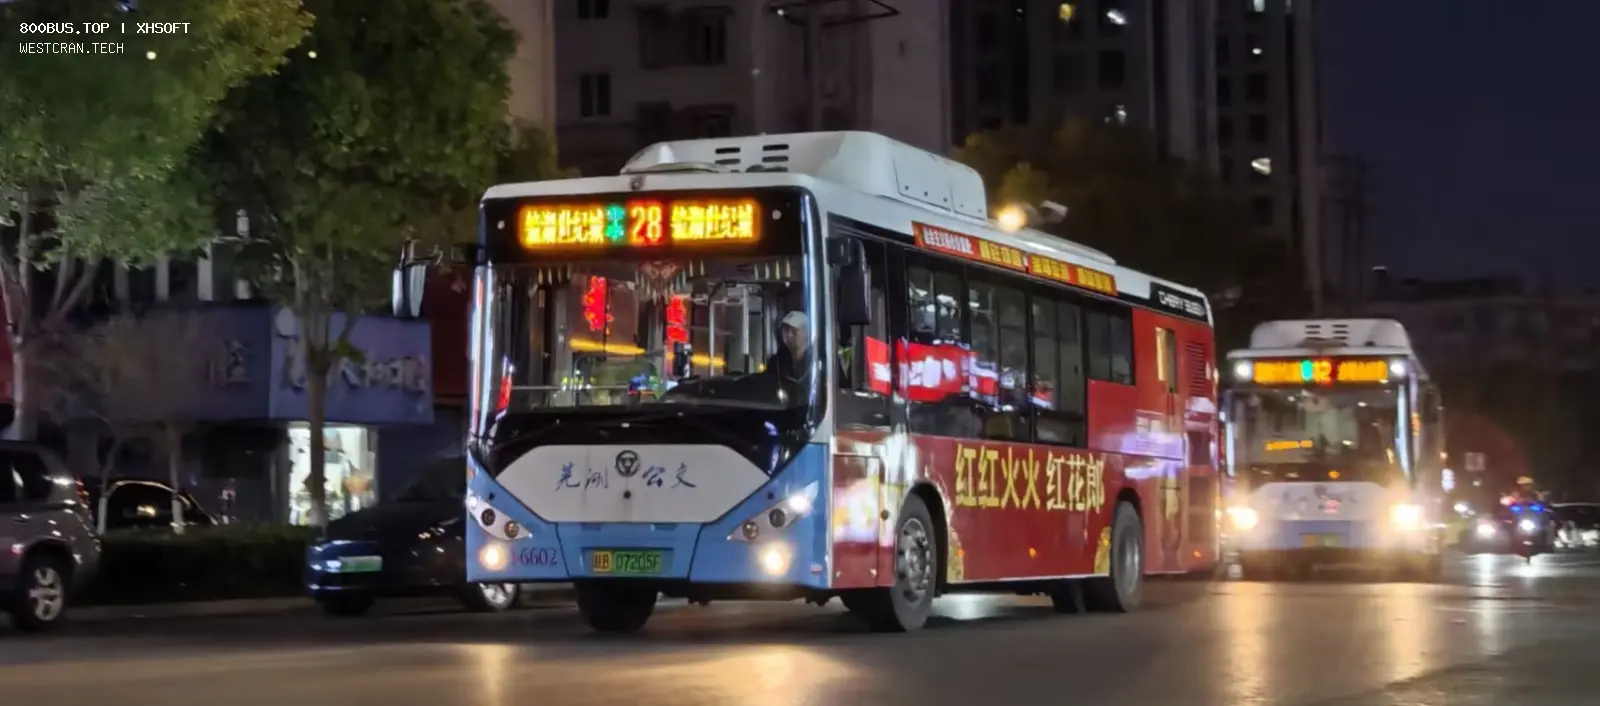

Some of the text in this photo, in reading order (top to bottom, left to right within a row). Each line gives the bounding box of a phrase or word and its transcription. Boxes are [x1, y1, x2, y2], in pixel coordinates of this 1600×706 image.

[630, 204, 662, 243] 28
[554, 461, 697, 491] 芜湖 公交
[955, 443, 1106, 514] 红红火火 红花郎
